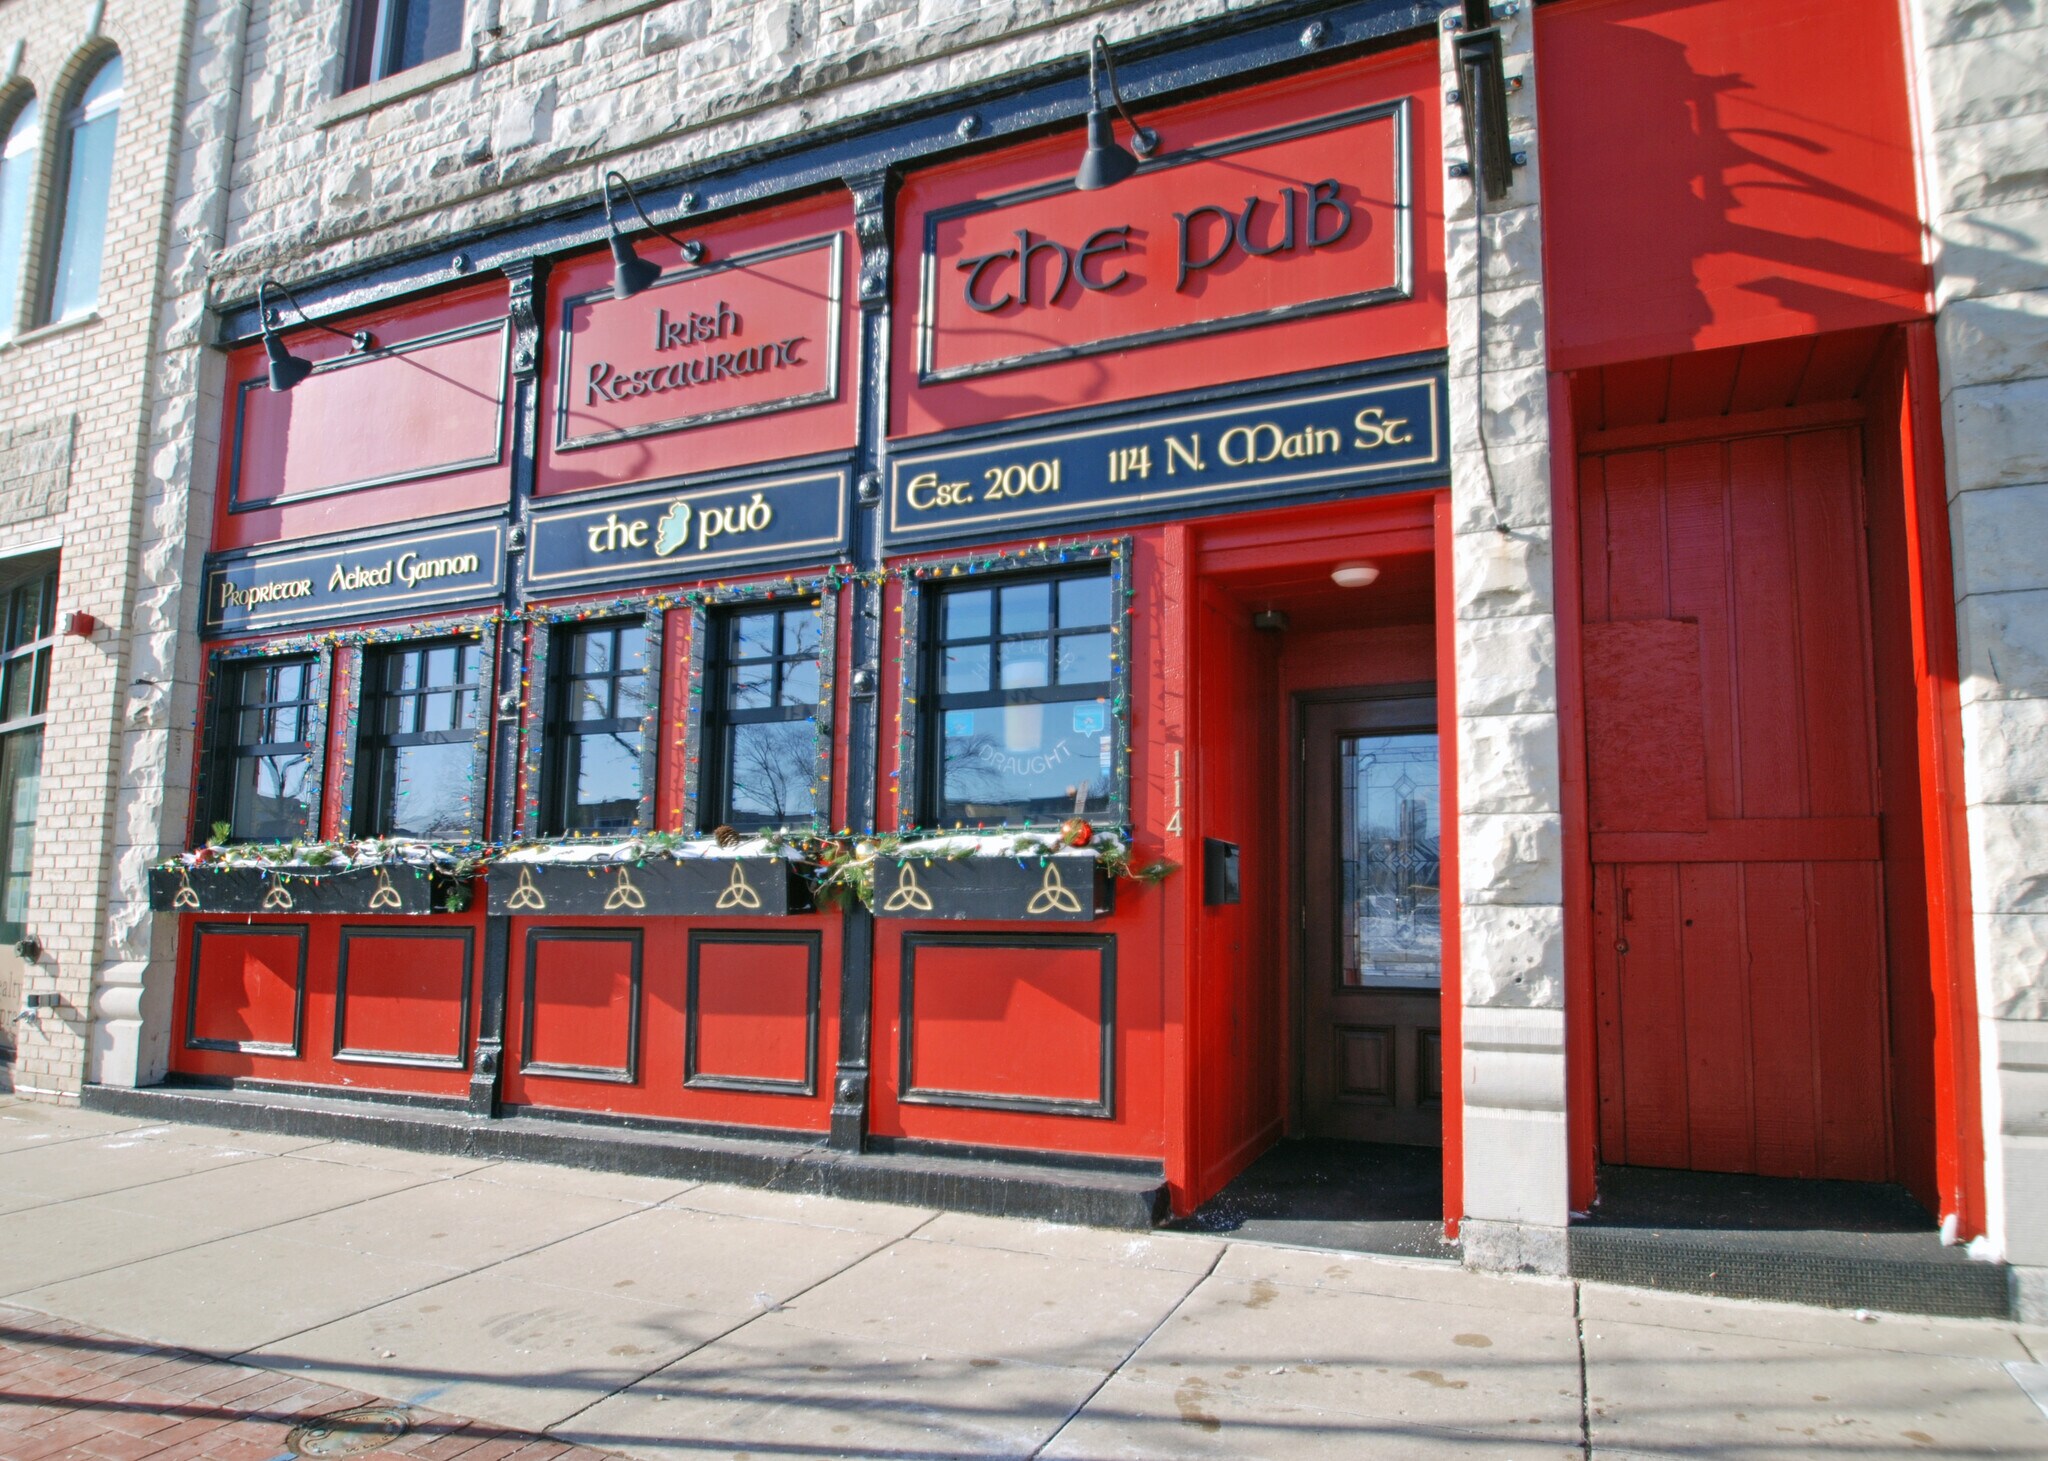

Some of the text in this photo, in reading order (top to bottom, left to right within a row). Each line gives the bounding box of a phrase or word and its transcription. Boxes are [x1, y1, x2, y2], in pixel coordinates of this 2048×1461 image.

[1172, 178, 1352, 292] PUB
[653, 300, 736, 351] Irish
[585, 336, 806, 406] Restaurant
[906, 408, 1413, 510] Est. 2001 114 N. Main St.
[588, 493, 772, 553] the pub
[221, 552, 478, 612] Proprietor Aelred Gannon
[978, 739, 1072, 775] DRAUGHT
[1166, 749, 1183, 838] 114
